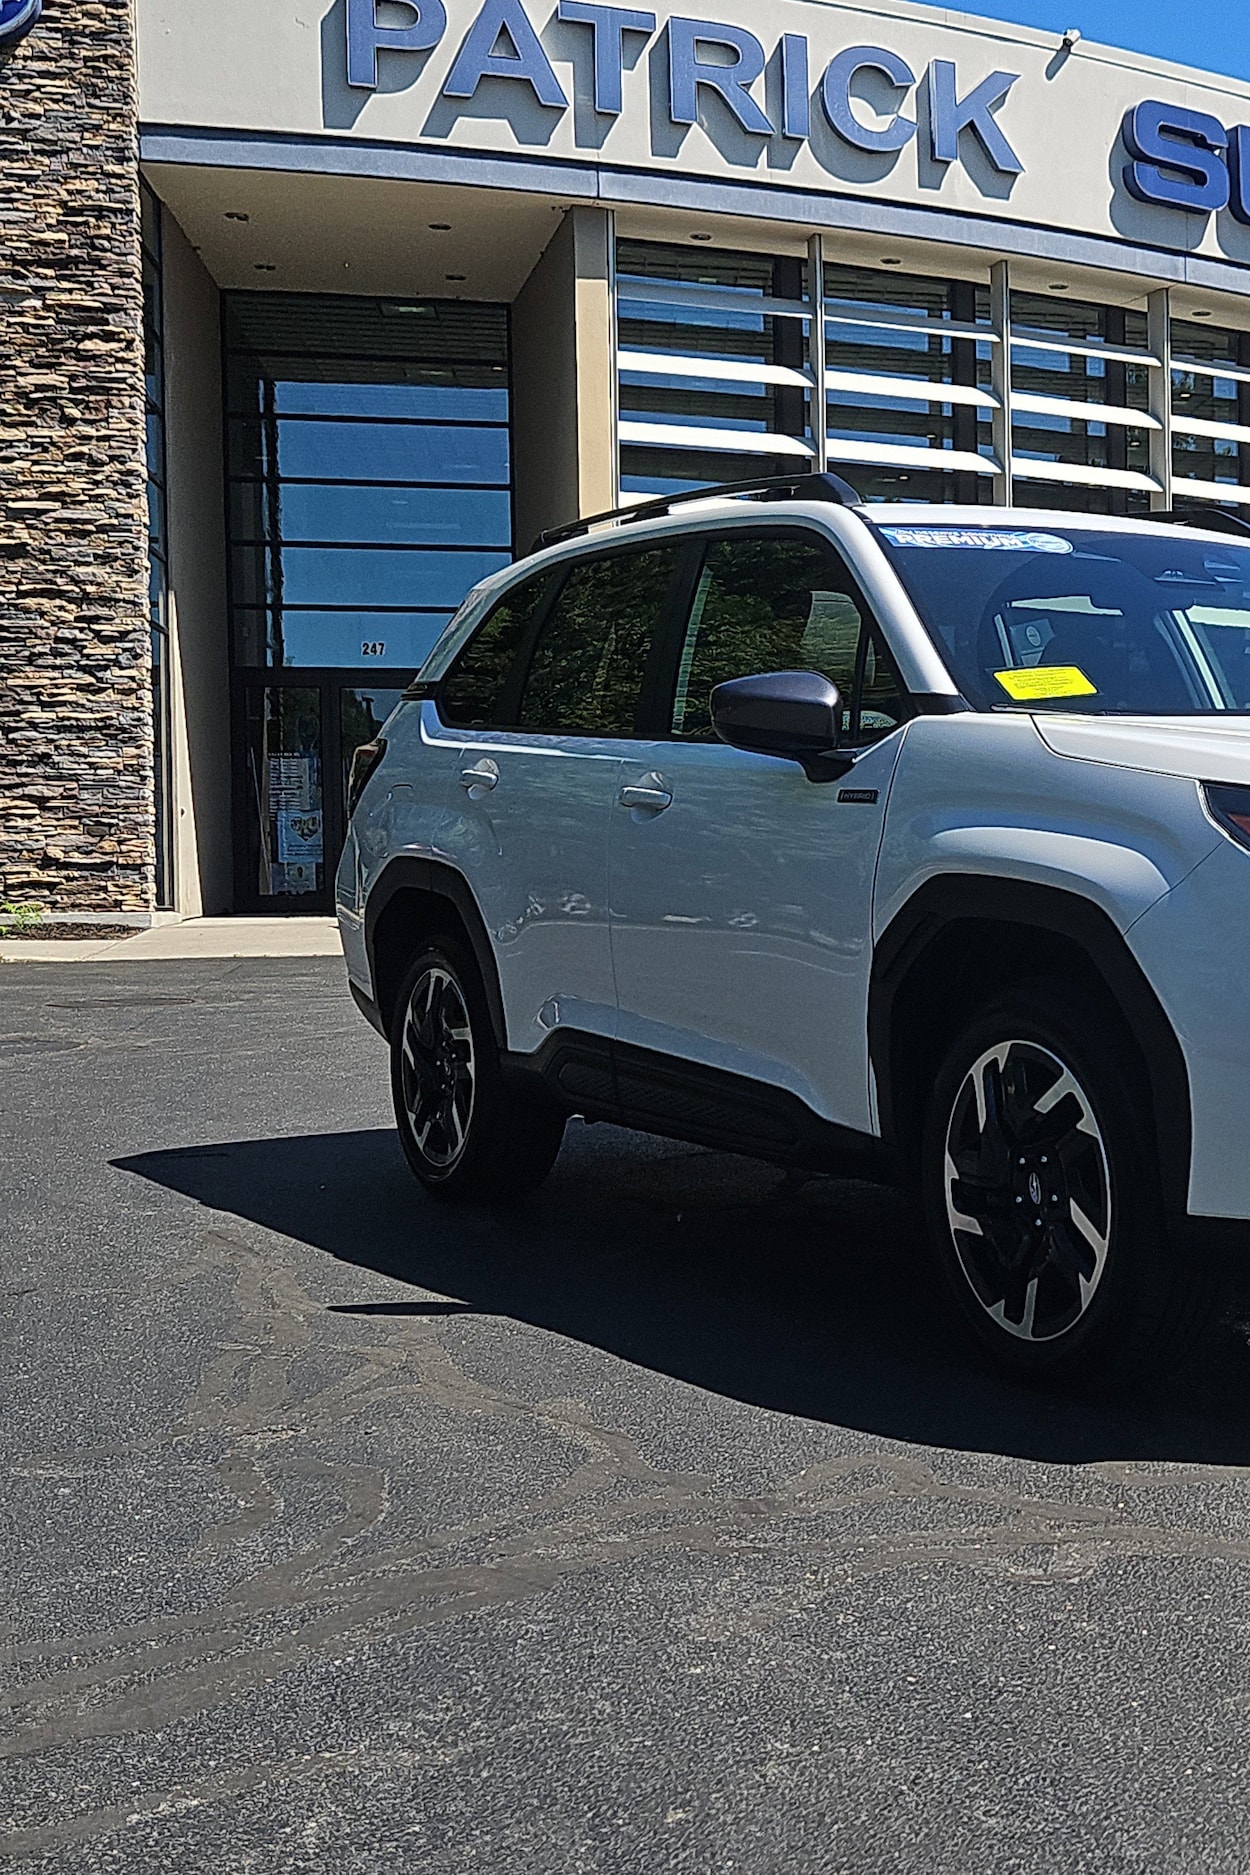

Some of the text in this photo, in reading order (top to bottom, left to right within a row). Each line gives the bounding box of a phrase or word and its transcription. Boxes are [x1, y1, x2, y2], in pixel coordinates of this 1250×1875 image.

[346, 0, 1024, 174] PATRICK
[897, 533, 1025, 549] PREMIUM
[362, 642, 385, 656] 247
